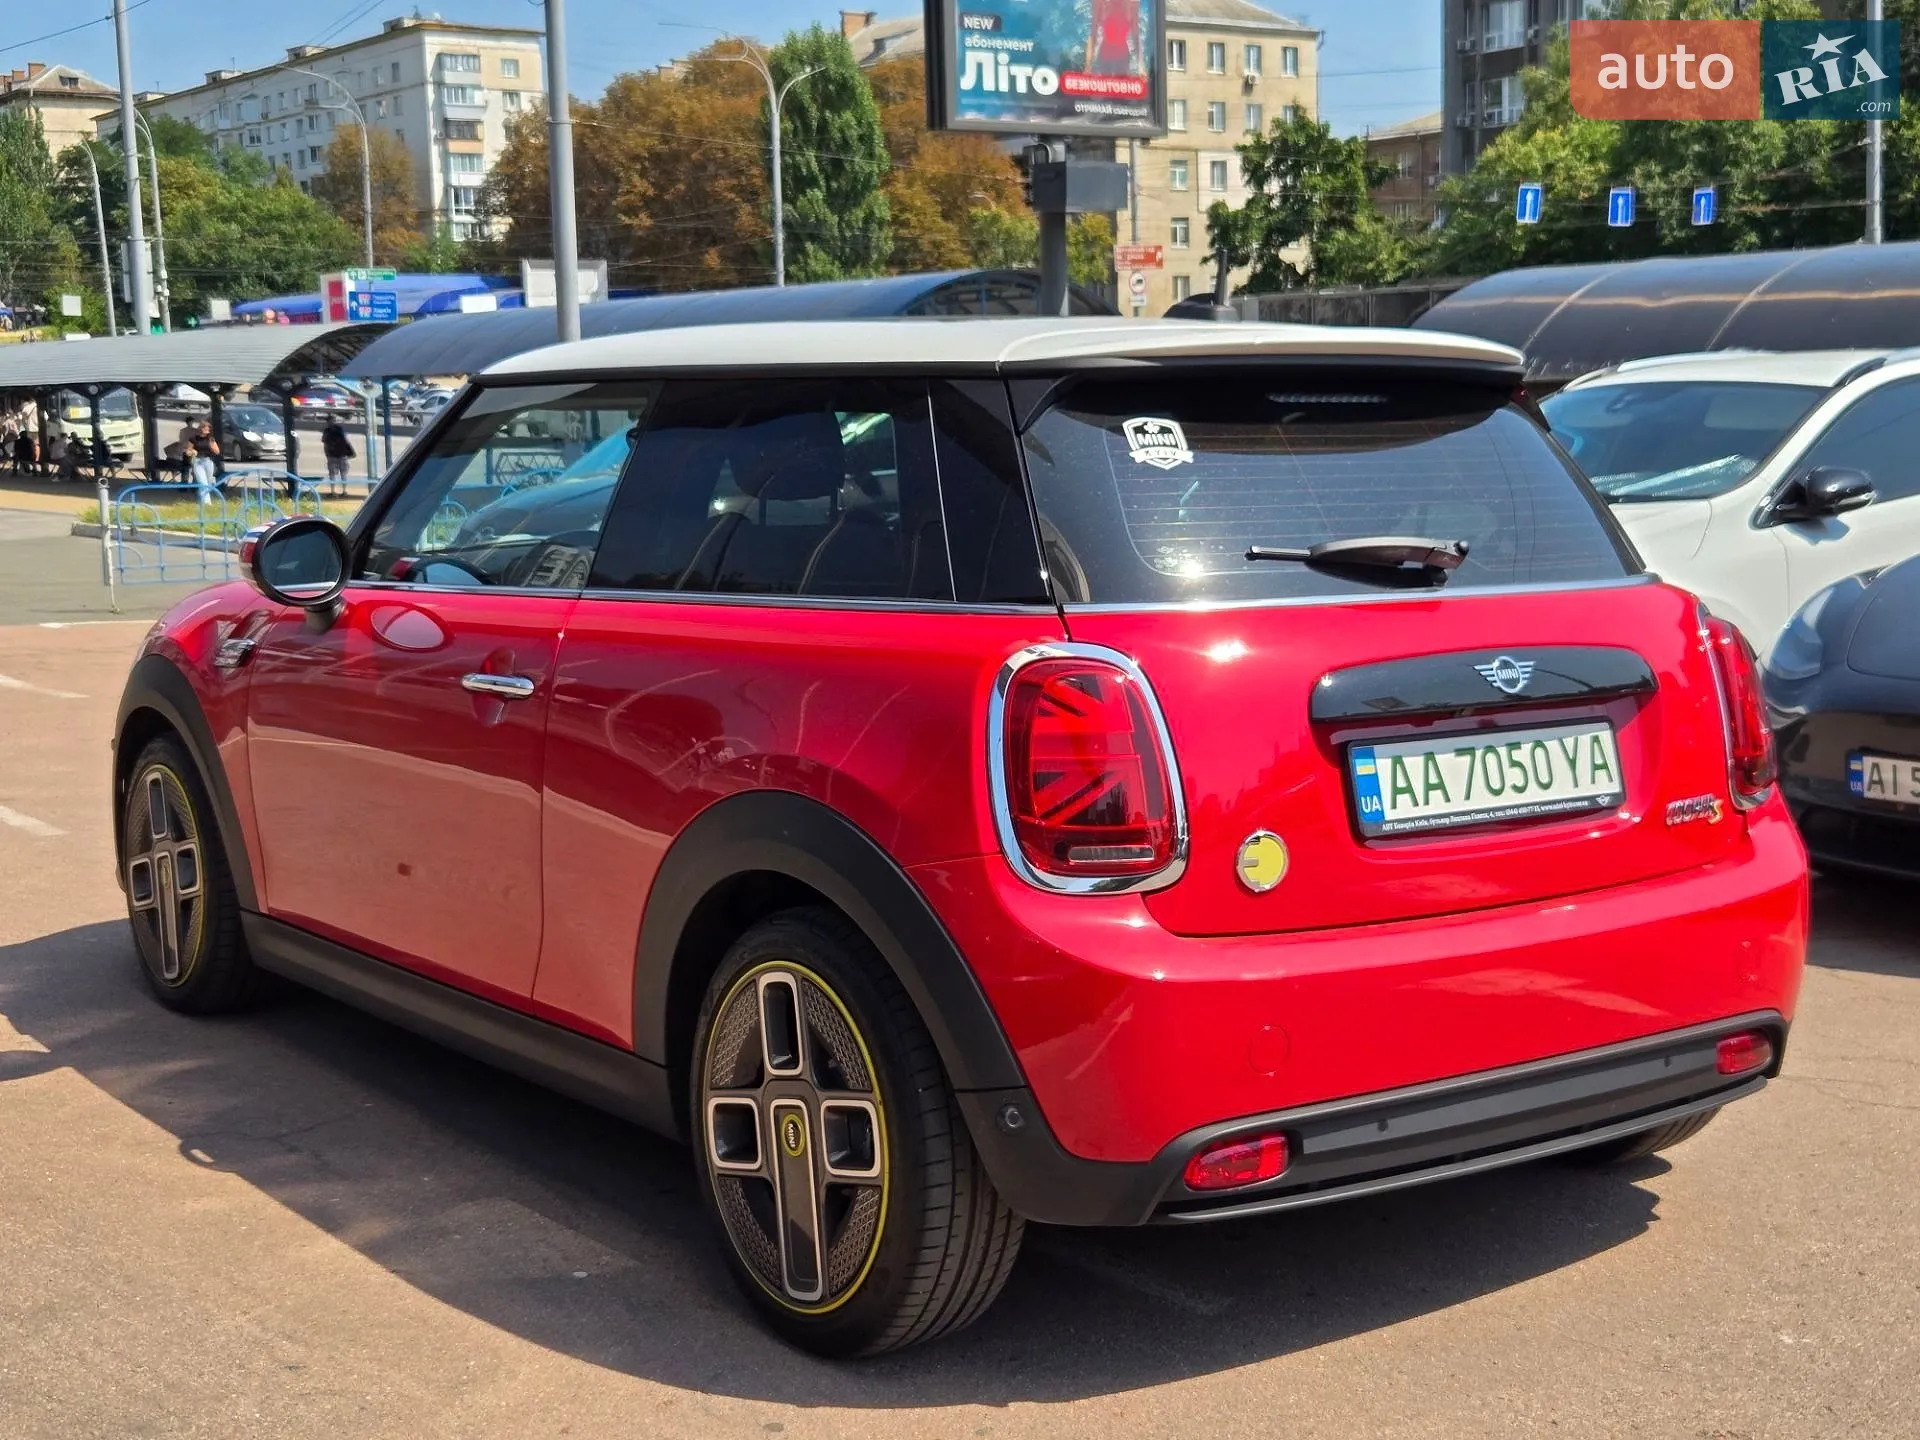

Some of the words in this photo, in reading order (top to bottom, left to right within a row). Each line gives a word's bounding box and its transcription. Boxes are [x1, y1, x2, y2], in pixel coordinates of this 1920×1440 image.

[963, 15, 994, 30] NEW
[964, 34, 1034, 52] абонемент
[960, 51, 1060, 96] Літо
[1136, 433, 1178, 446] MINI
[1497, 668, 1519, 680] MINI
[1390, 751, 1451, 810] AA
[1454, 739, 1554, 801] 7050
[1557, 734, 1614, 789] YA
[1850, 781, 1863, 792] UA
[1361, 795, 1382, 814] UA
